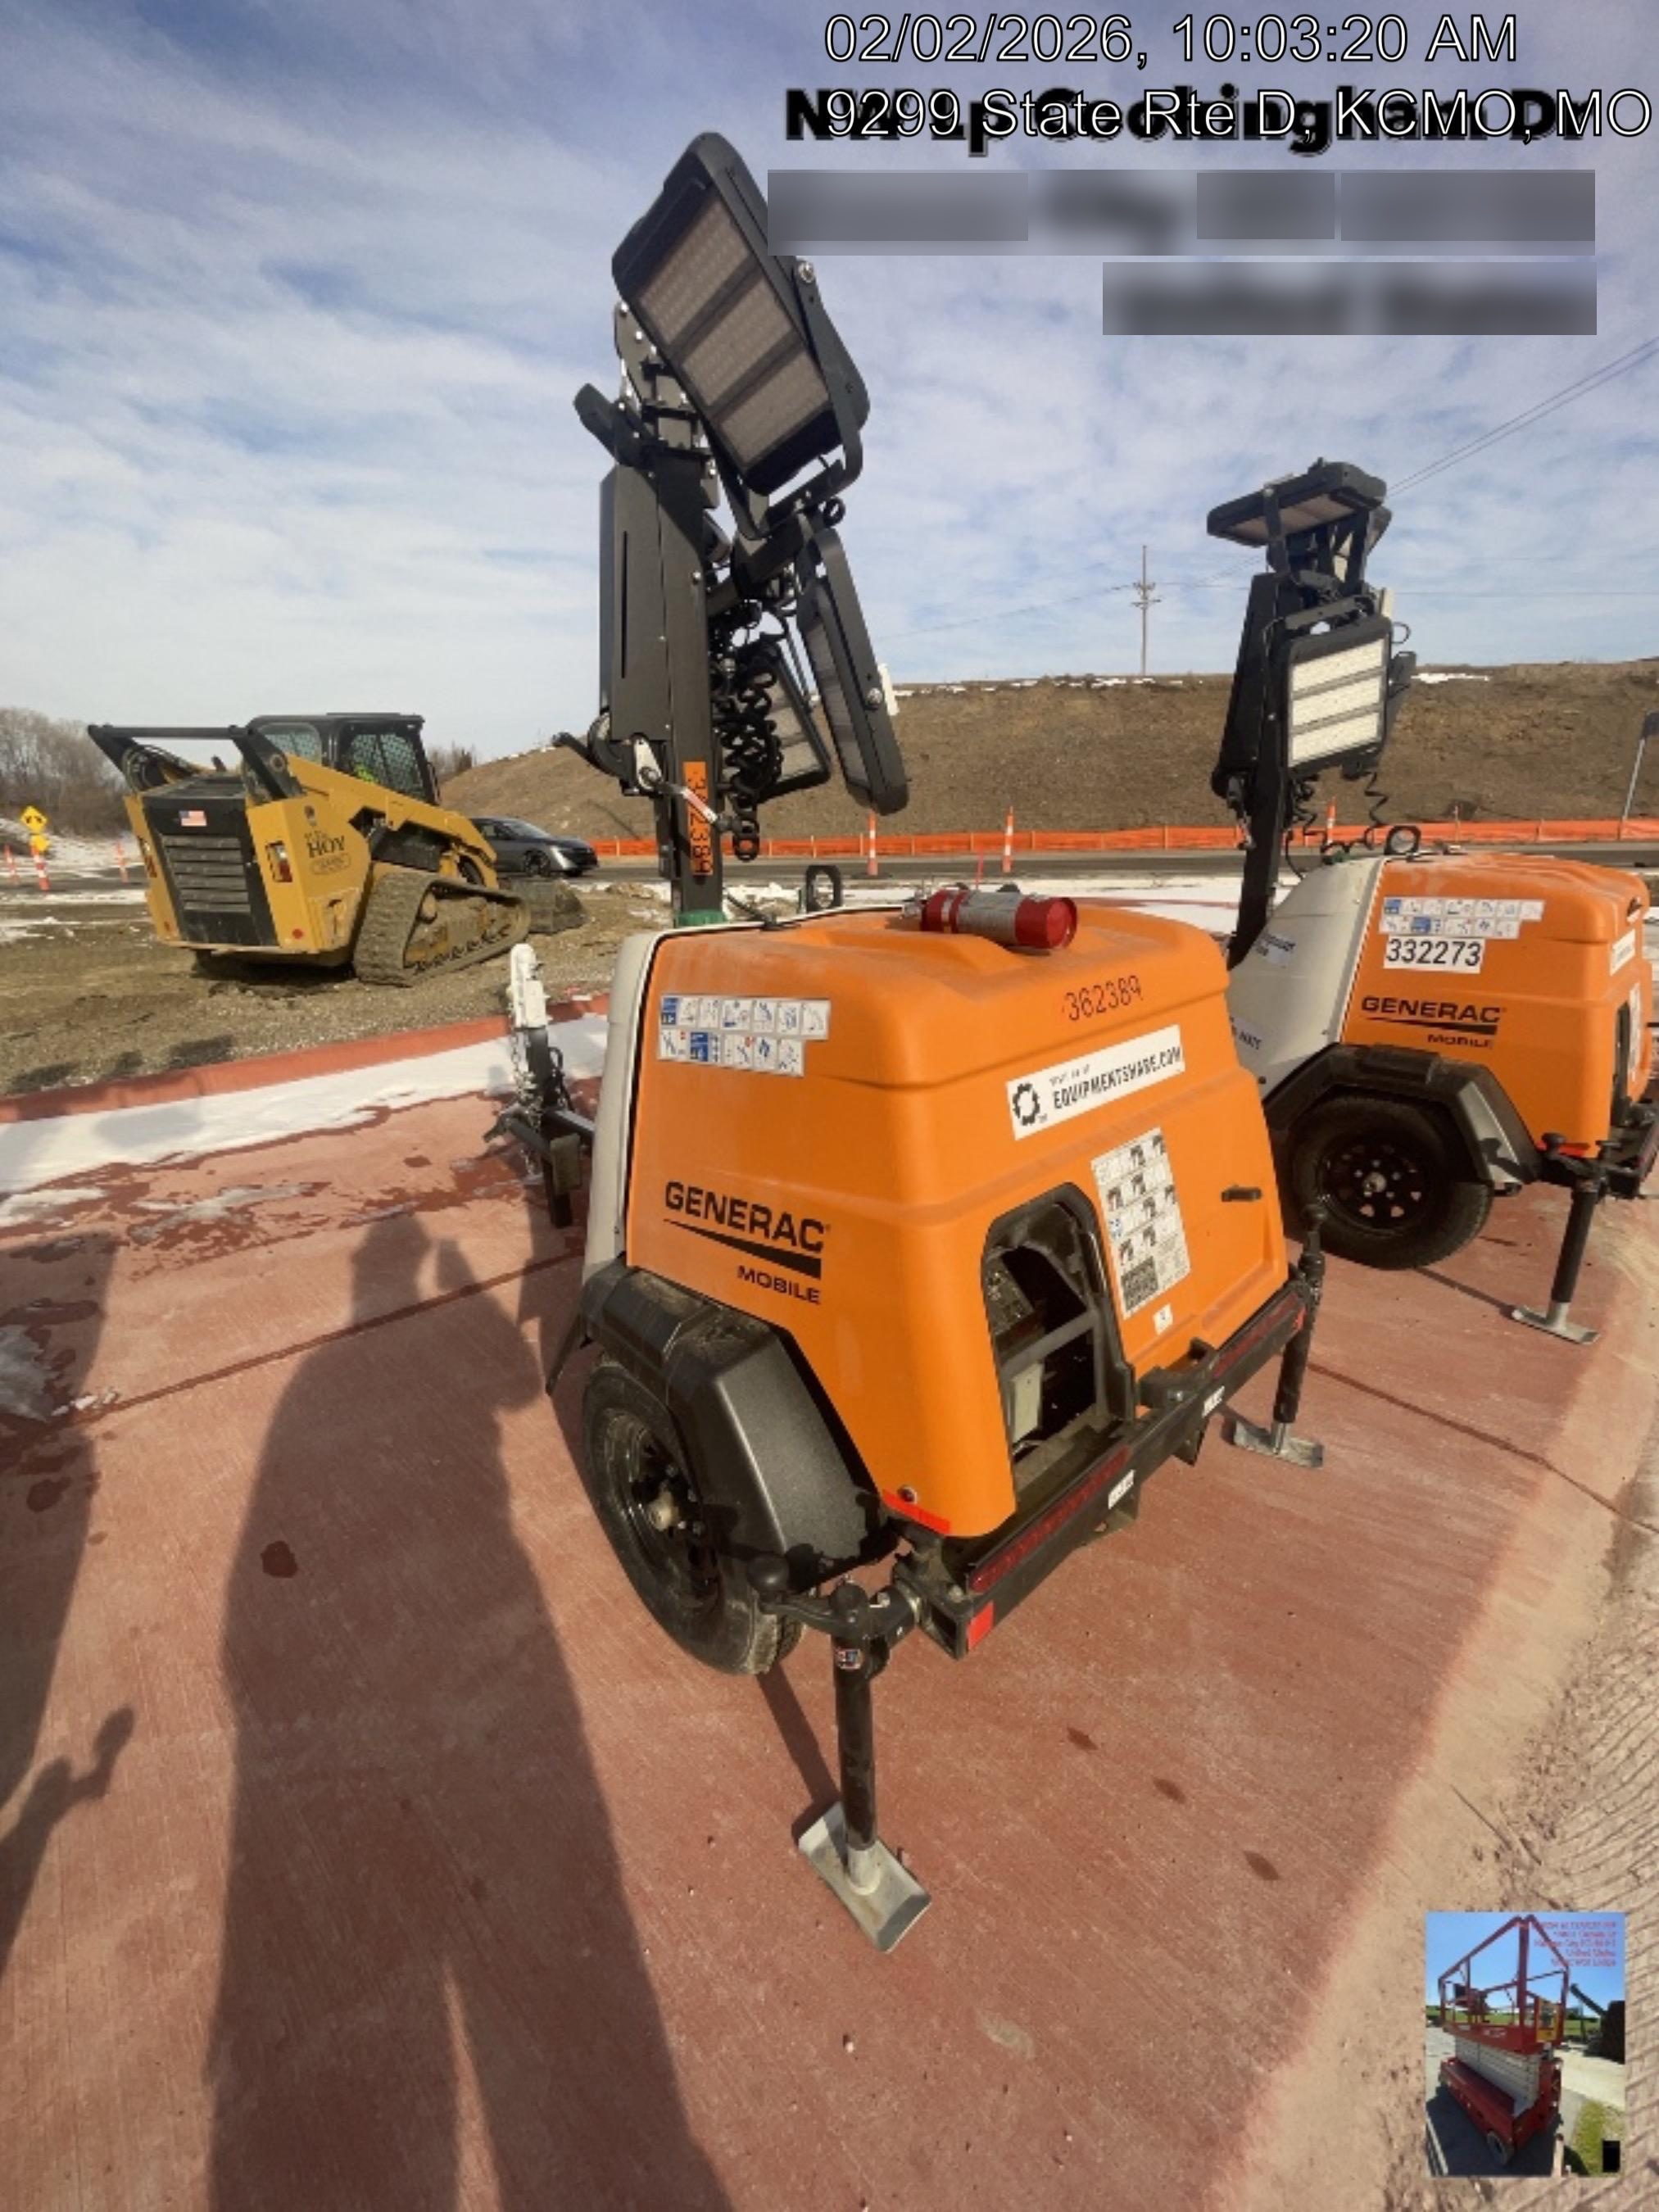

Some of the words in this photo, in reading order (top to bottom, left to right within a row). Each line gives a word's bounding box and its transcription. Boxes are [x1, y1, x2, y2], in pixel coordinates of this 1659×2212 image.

[1386, 938, 1481, 967] 332273
[1066, 974, 1144, 1021] 362389
[1361, 995, 1501, 1023] GENERAC
[1427, 1033, 1494, 1049] MOBILE
[1053, 1045, 1181, 1109] EQUIPMENTSHARE.COM
[665, 1181, 825, 1253] GENERAC
[738, 1265, 821, 1306] MOBILE
